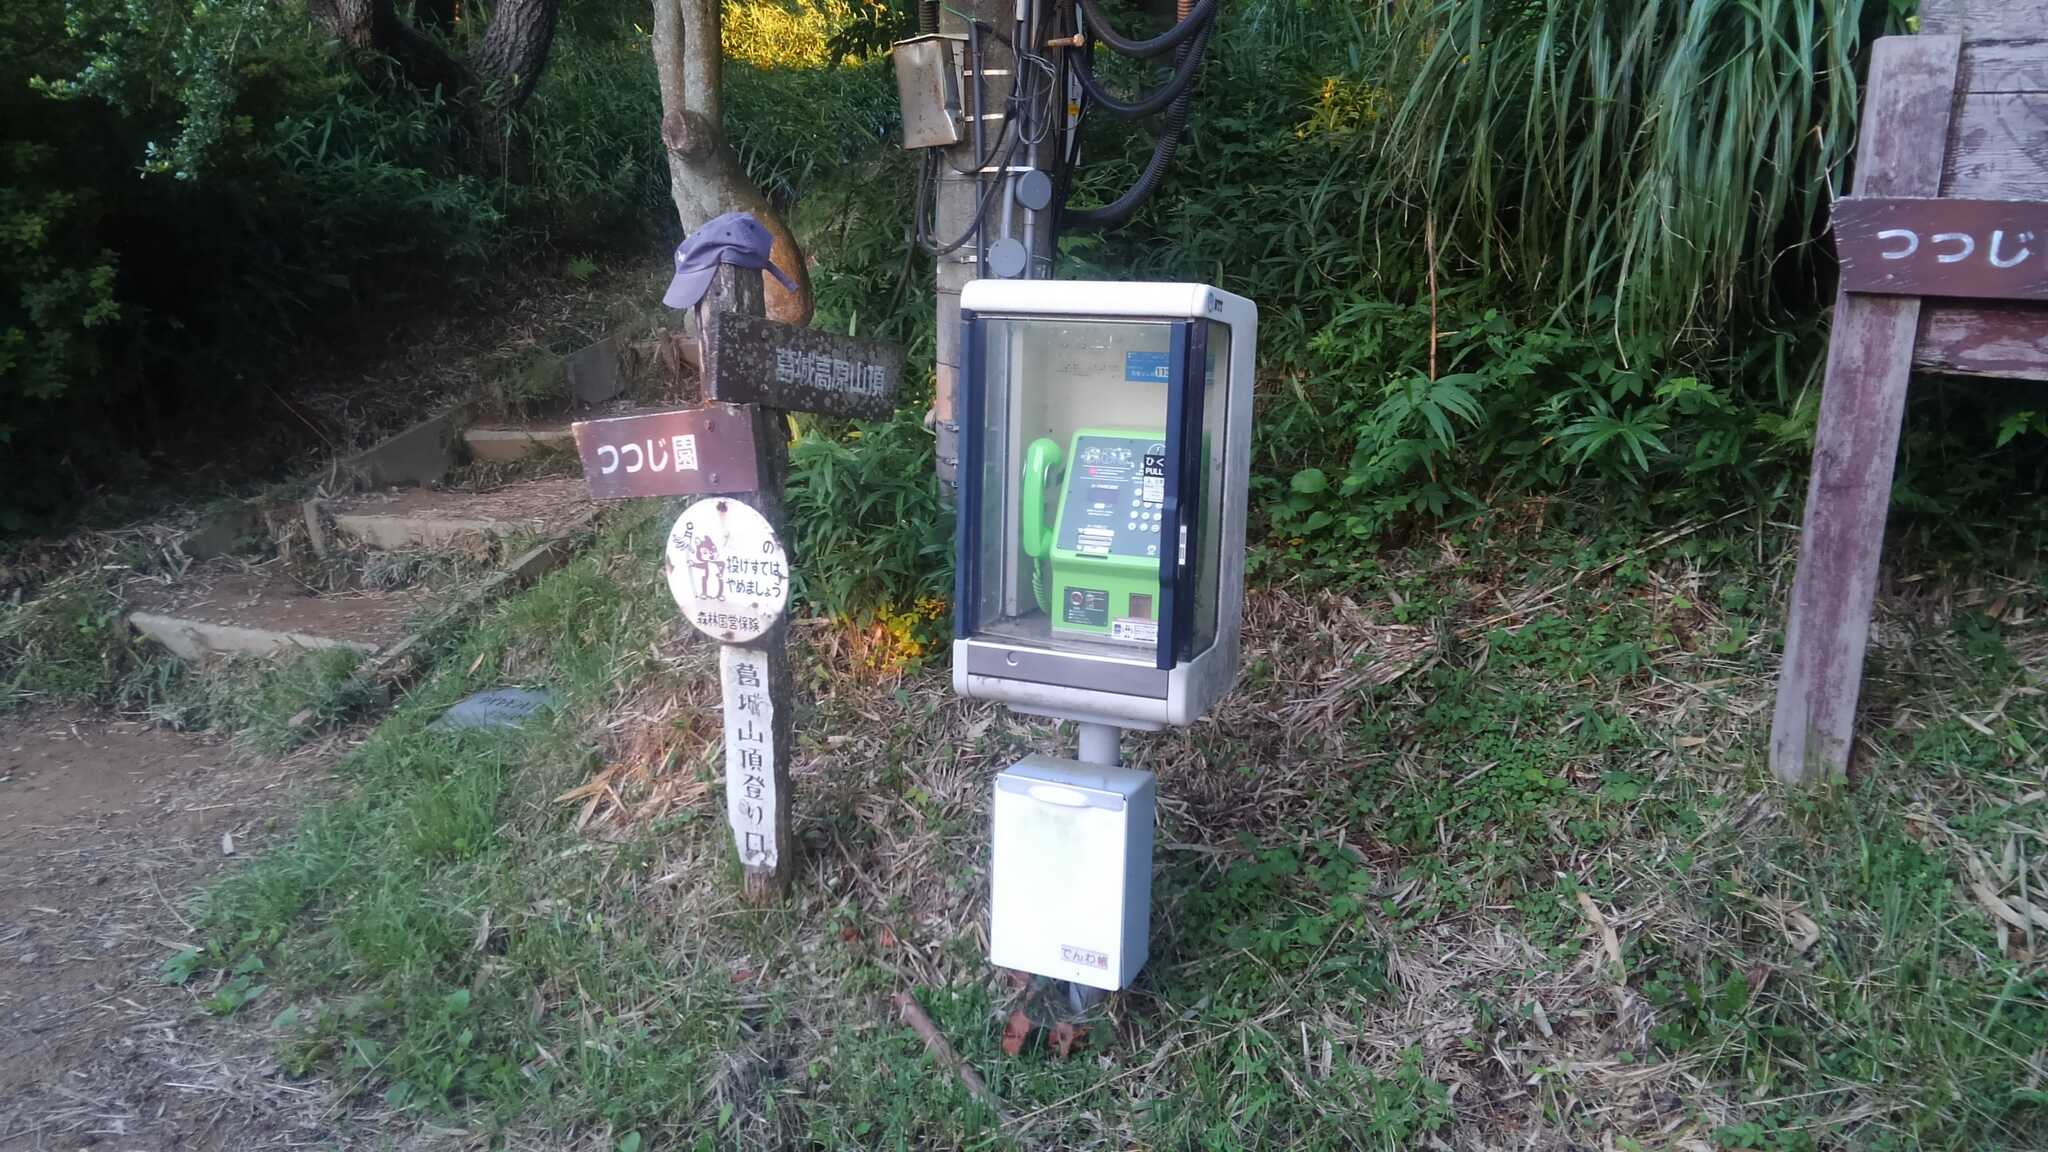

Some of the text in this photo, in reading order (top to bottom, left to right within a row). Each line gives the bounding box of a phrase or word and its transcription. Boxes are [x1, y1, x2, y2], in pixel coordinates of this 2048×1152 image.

[1877, 229, 2034, 268] つつじ
[597, 434, 699, 474] つつじ園
[1145, 467, 1164, 476] PULL
[726, 578, 781, 598] やめましょう
